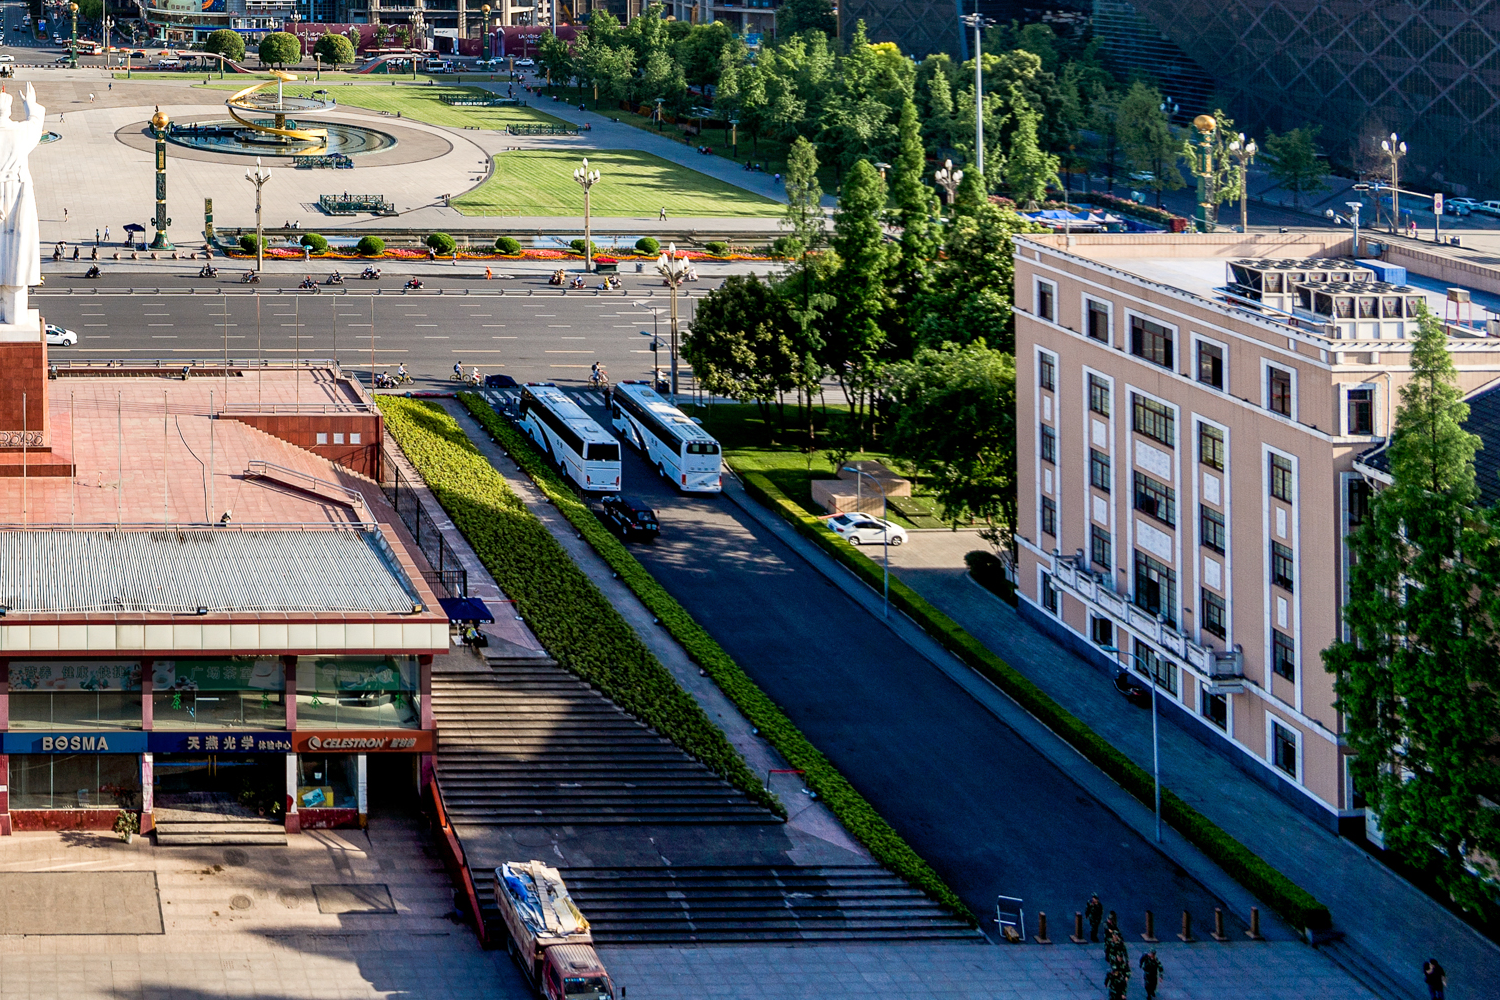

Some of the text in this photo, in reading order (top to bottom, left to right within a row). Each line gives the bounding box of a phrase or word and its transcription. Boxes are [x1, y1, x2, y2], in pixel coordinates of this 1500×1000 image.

[25, 665, 52, 679] 营养
[62, 665, 89, 679] 健康
[42, 735, 109, 751] BOSMA
[187, 735, 254, 750] 天燕光学
[322, 737, 386, 749] CELESTRON
